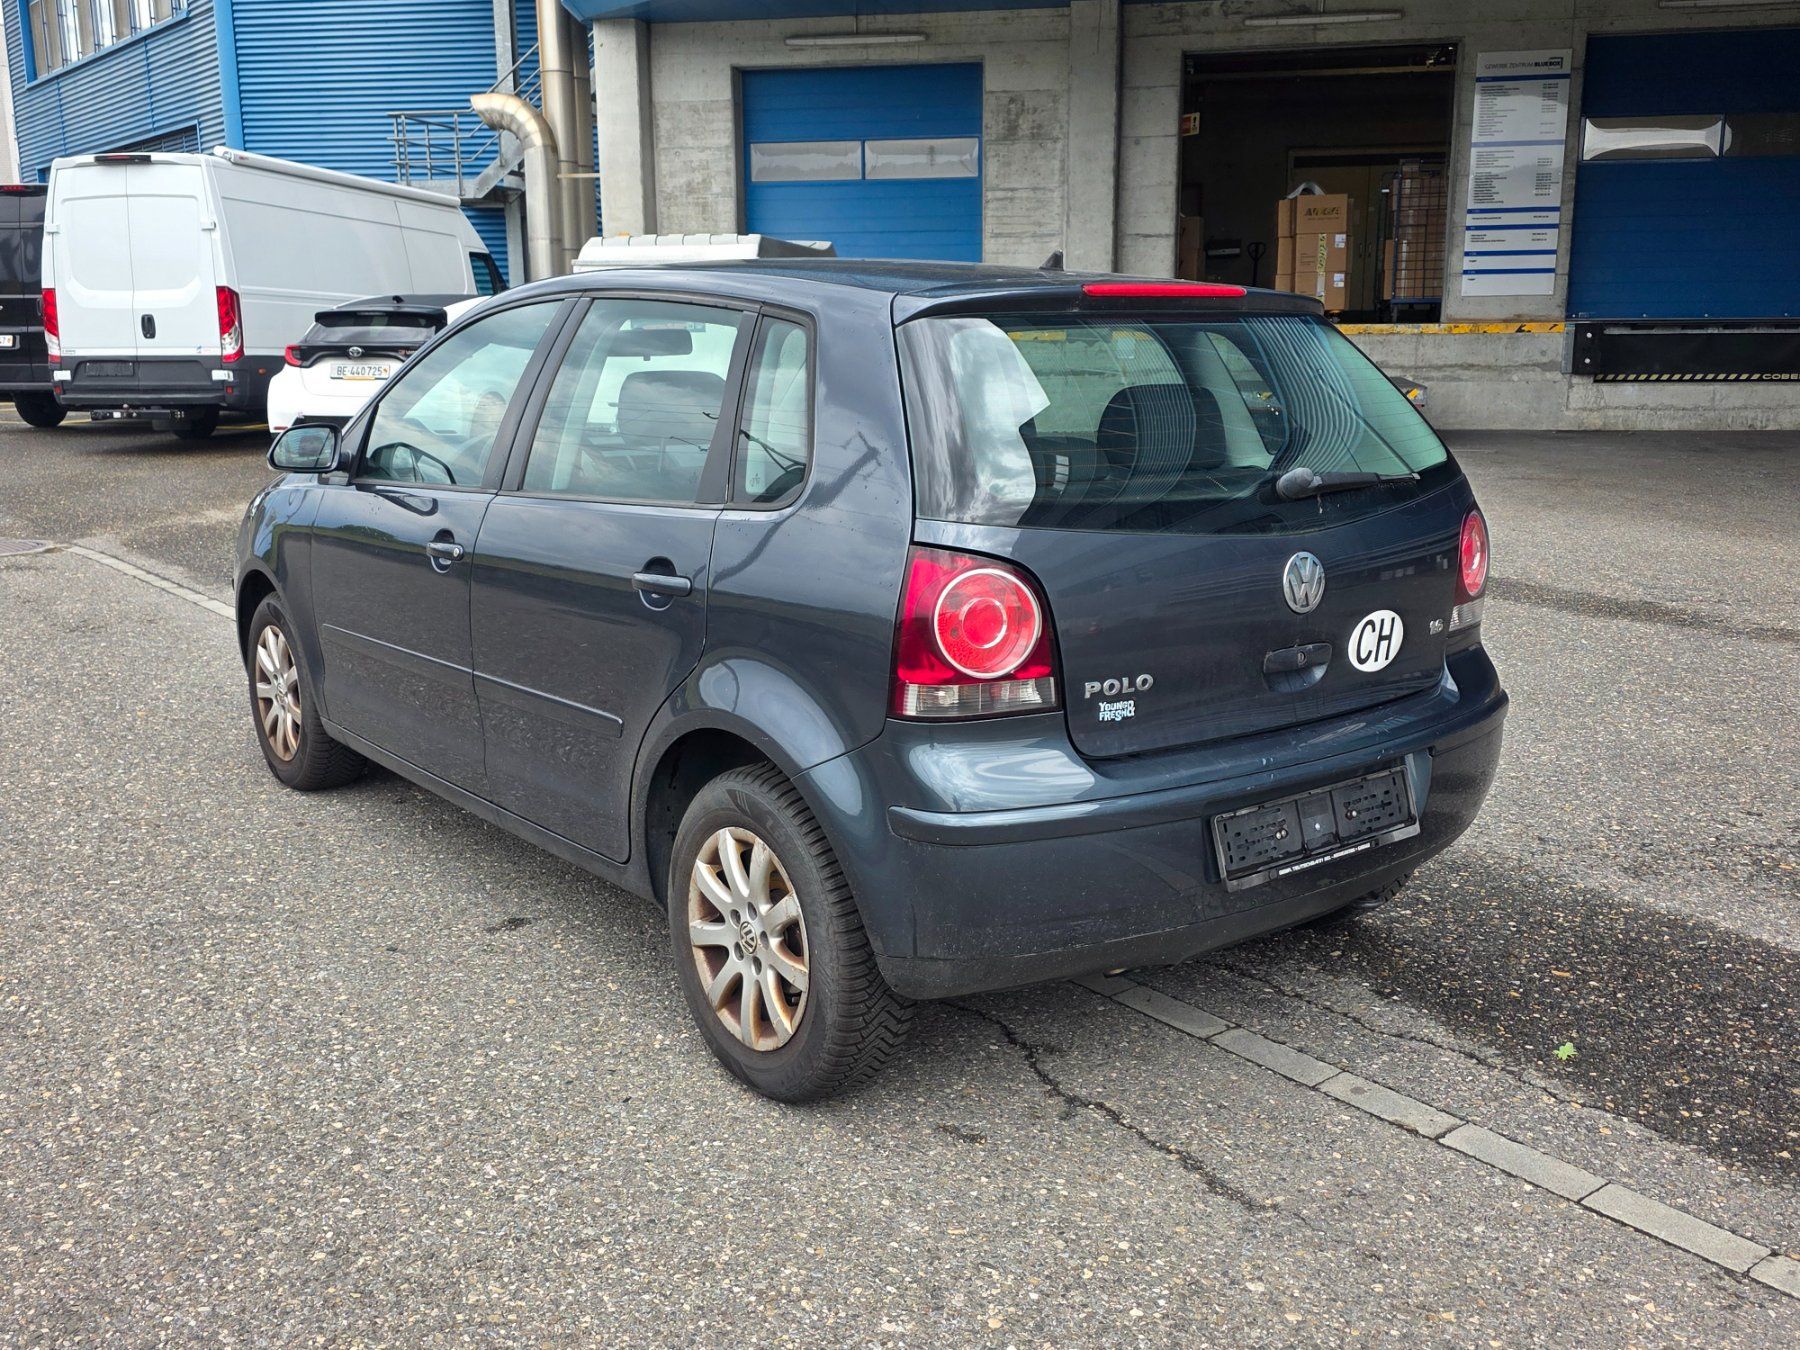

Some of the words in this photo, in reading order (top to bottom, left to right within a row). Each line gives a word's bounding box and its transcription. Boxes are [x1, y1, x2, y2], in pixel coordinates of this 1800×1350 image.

[1356, 616, 1396, 666] CH
[1084, 673, 1154, 699] POLO
[1098, 700, 1128, 712] YOUNG
